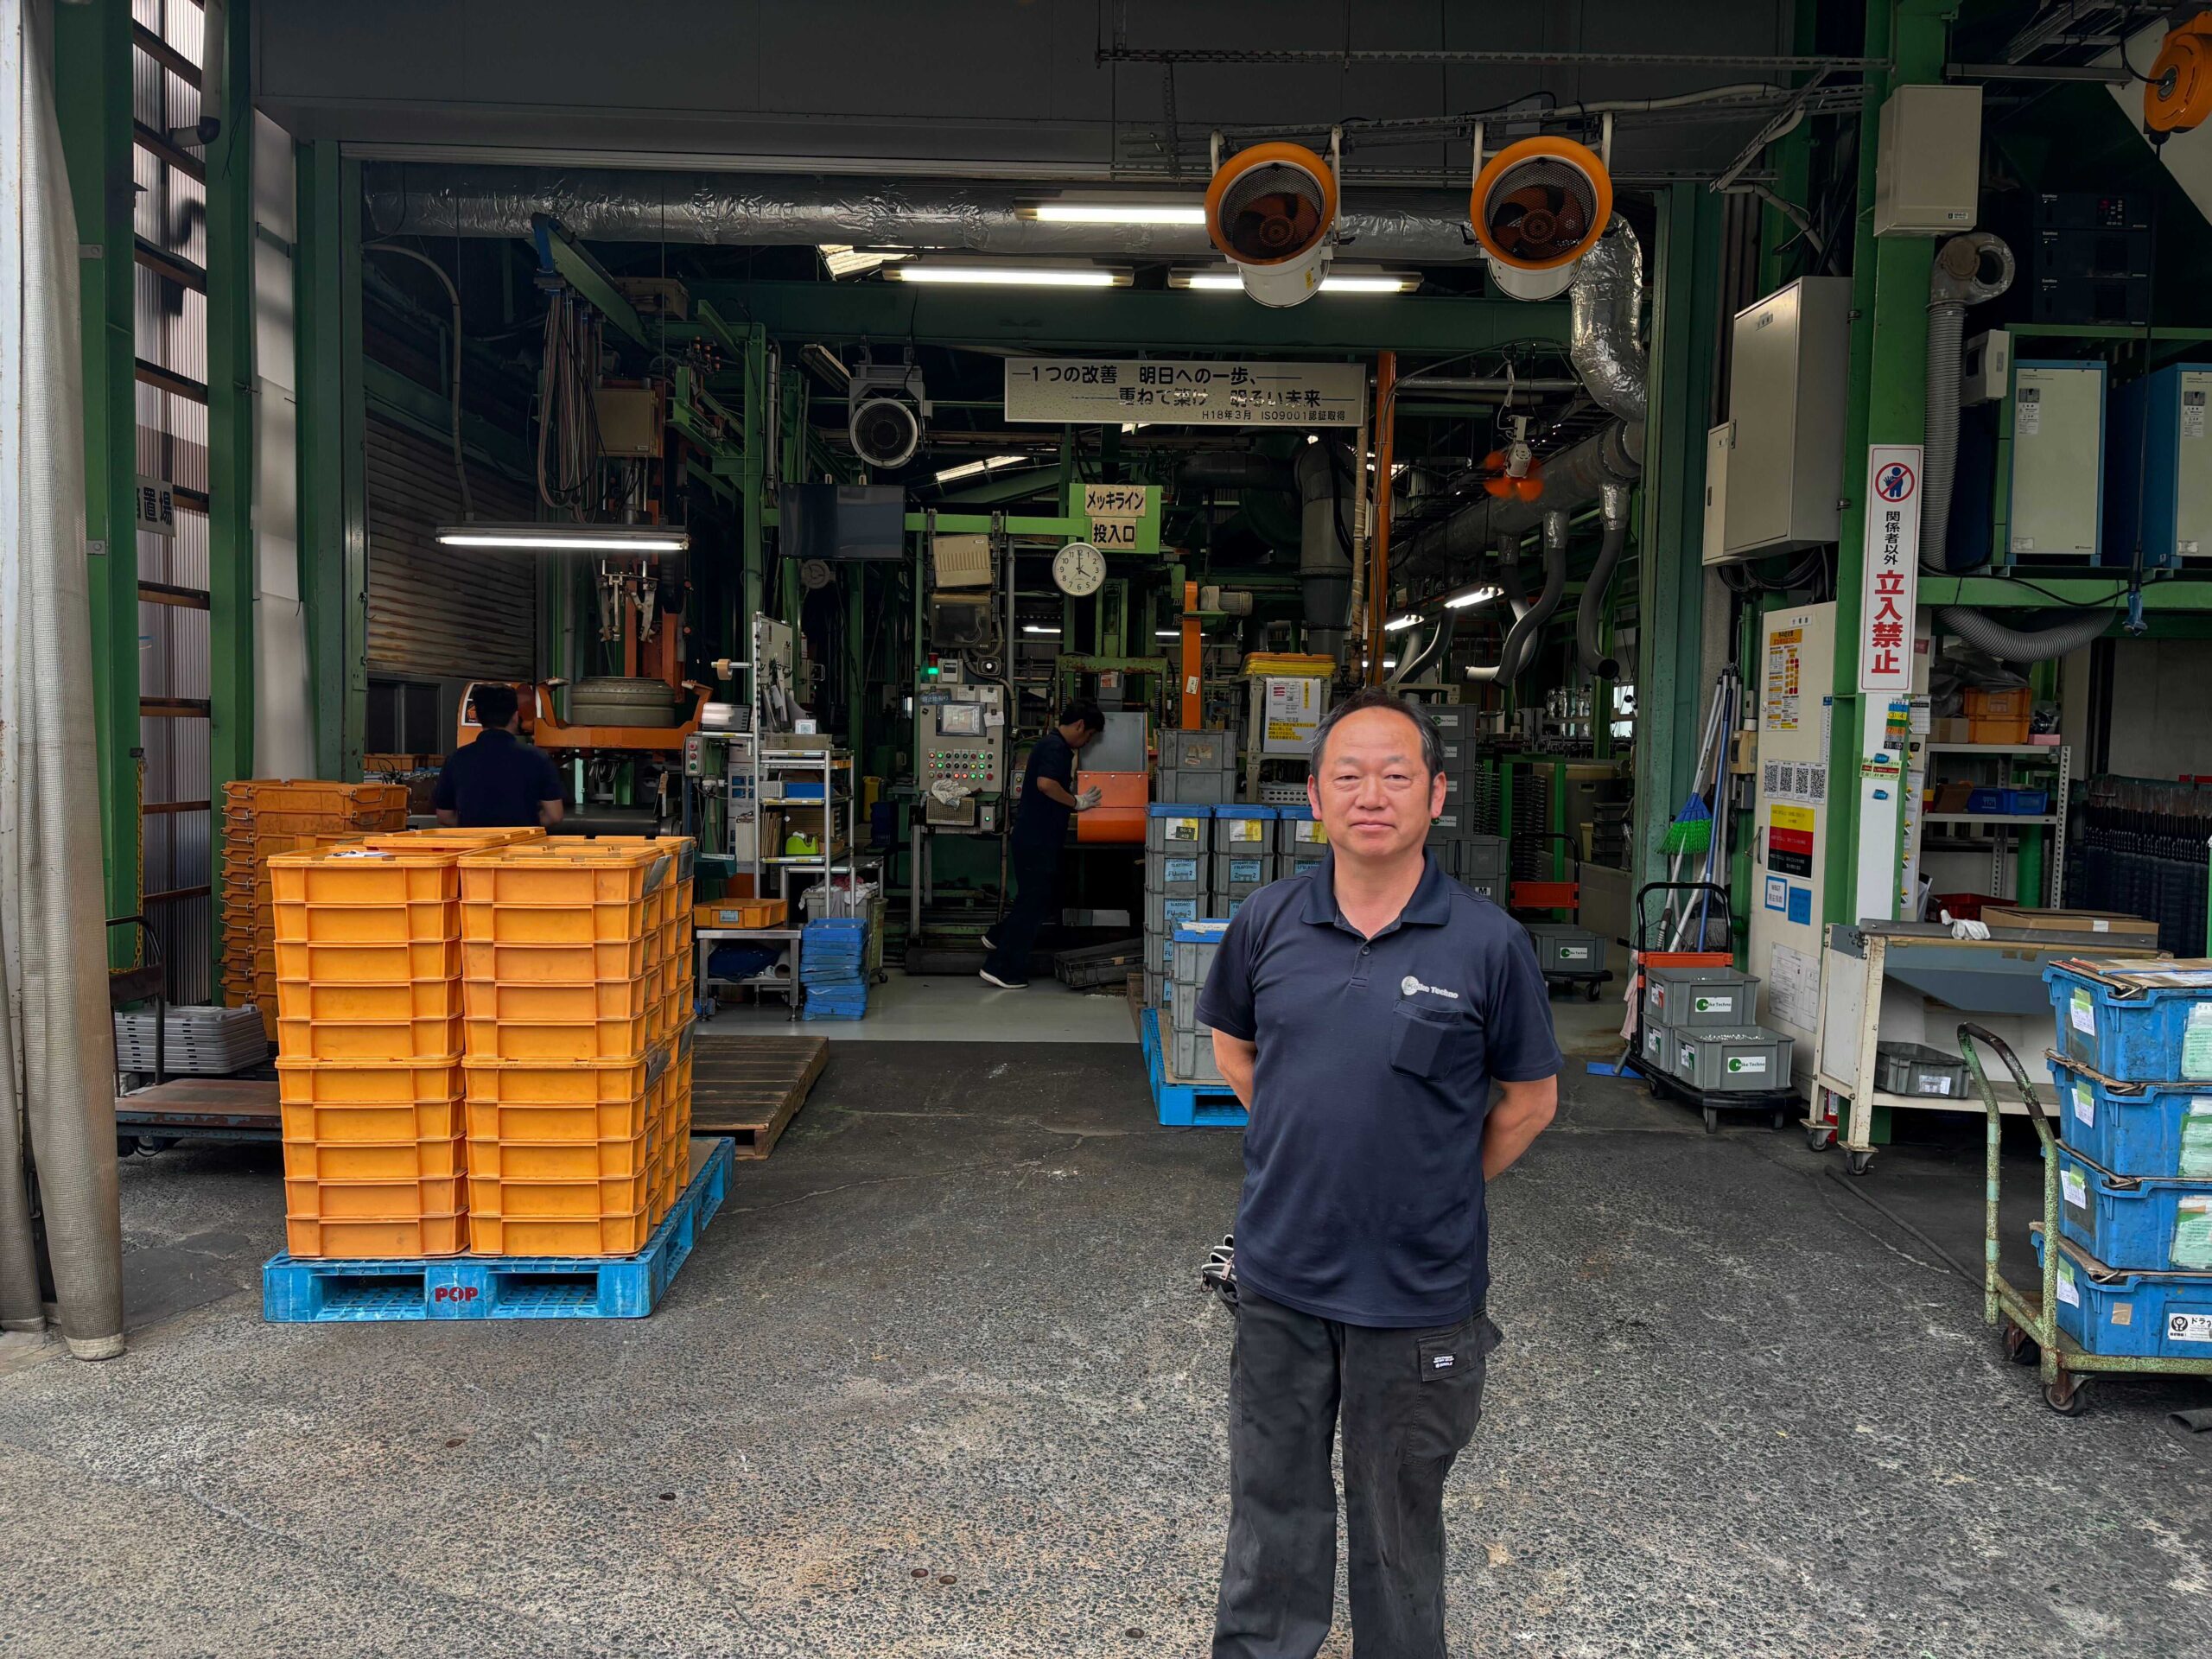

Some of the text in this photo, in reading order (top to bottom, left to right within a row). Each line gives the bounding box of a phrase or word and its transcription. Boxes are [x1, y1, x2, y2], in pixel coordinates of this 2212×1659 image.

[1032, 365, 1117, 384] 1つの改善
[137, 487, 172, 525] 置場
[1087, 491, 1143, 510] メッキライン
[1093, 524, 1135, 543] 投入口
[1884, 511, 1900, 566] 関係者以外
[1872, 570, 1904, 674] 立入禁止
[1430, 986, 1459, 999] Techno
[435, 1287, 479, 1302] POP
